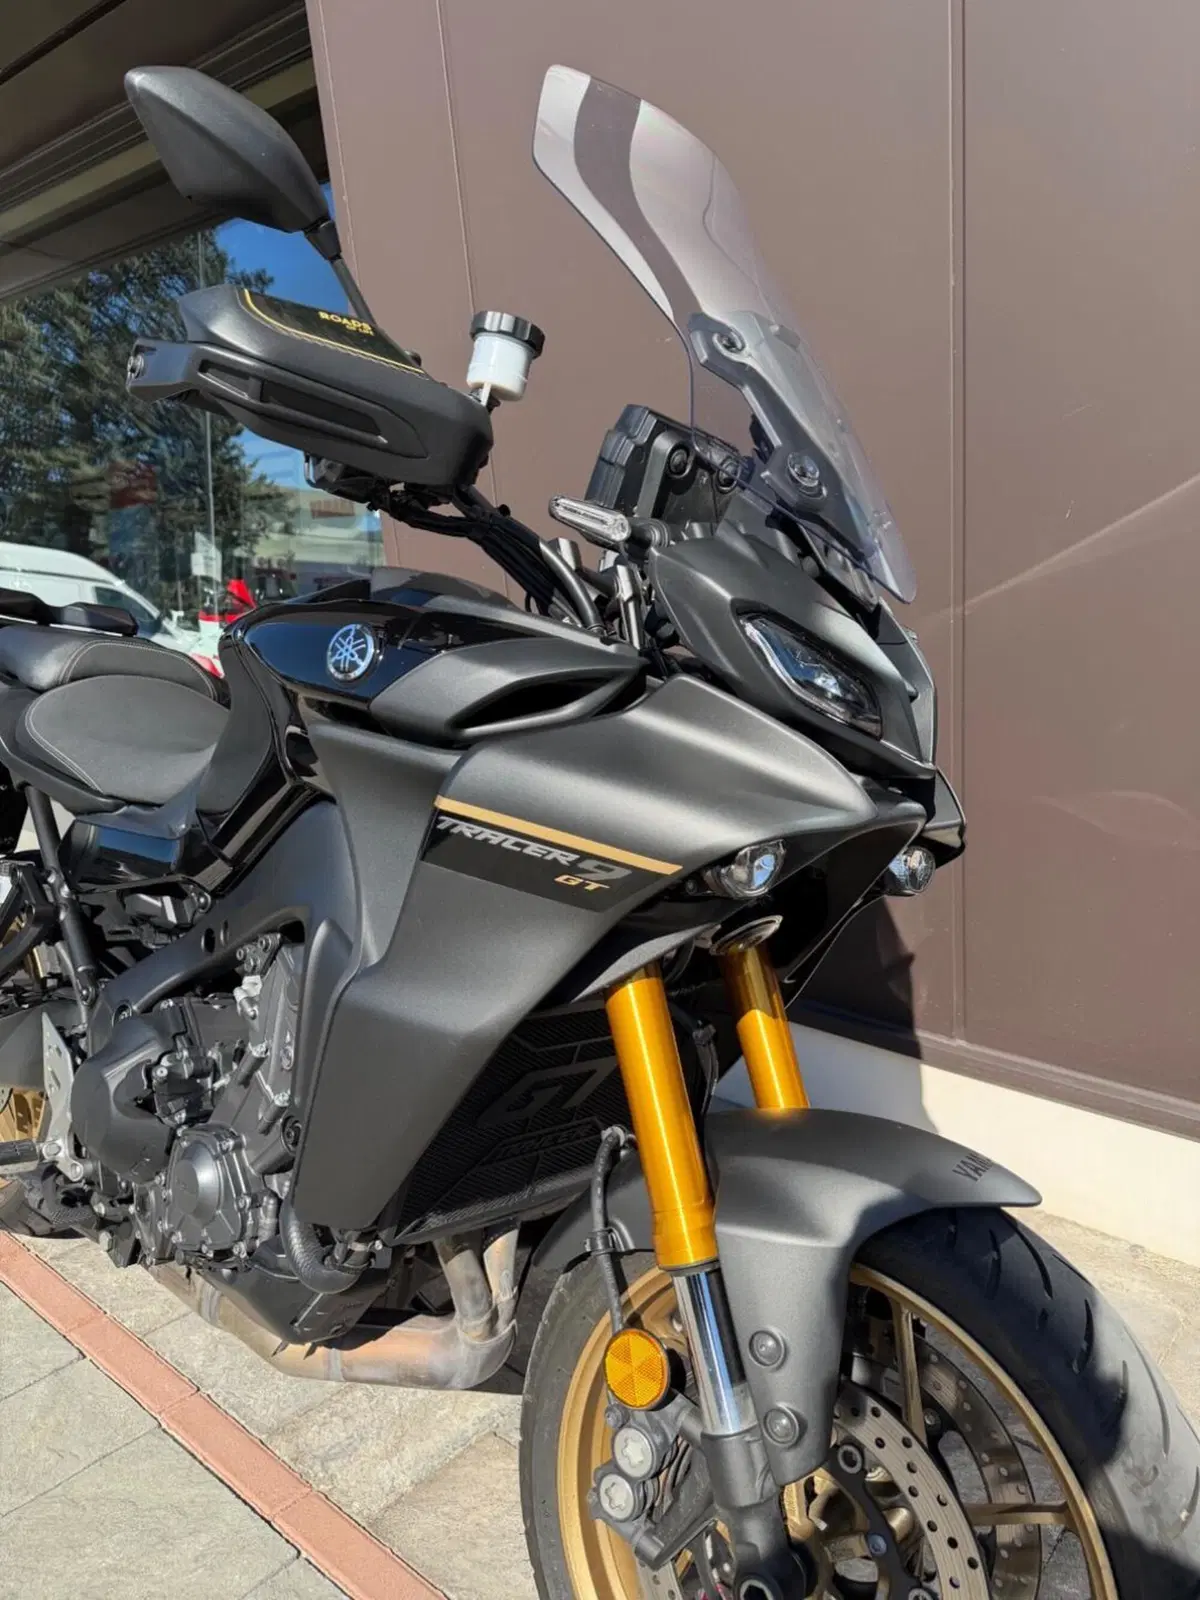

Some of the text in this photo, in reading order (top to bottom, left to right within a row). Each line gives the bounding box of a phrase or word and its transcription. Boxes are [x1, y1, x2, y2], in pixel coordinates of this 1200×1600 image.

[437, 815, 581, 867] TRACER
[554, 874, 610, 891] GT
[952, 1151, 992, 1182] YAM
